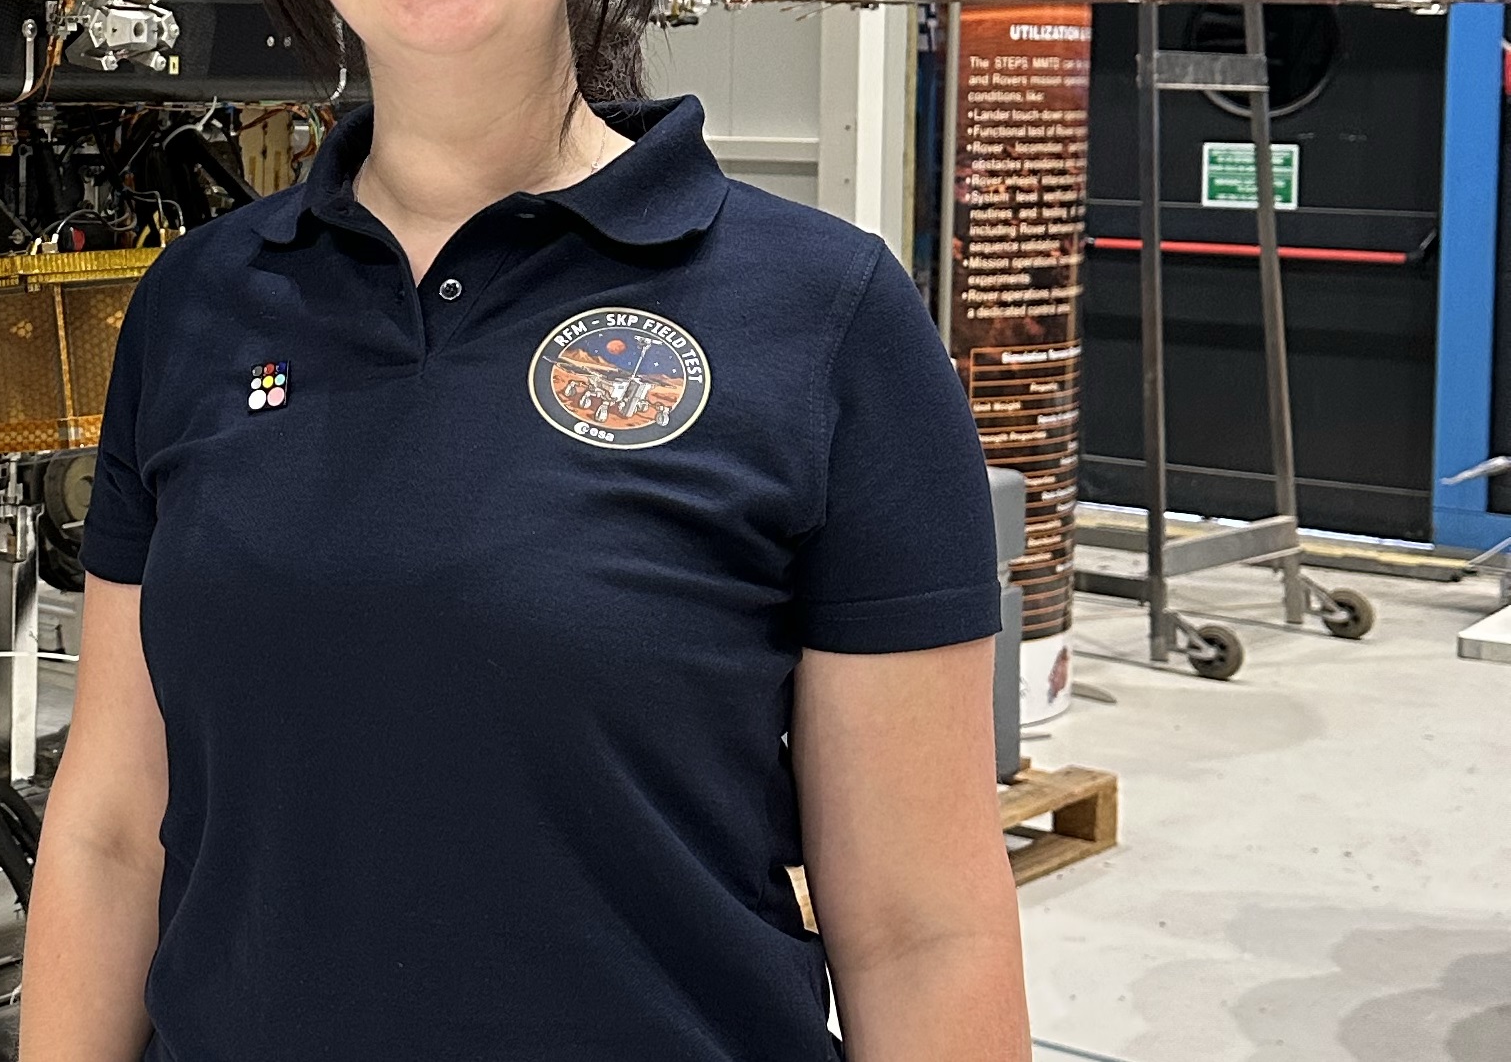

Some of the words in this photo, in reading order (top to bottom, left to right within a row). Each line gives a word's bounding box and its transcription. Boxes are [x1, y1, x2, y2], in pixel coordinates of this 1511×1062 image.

[1010, 24, 1080, 41] UTILIZATION
[969, 55, 989, 69] The
[994, 55, 1028, 70] STEPS
[969, 73, 989, 87] and
[974, 107, 1010, 121] Lander
[972, 140, 1004, 154] Rover
[553, 321, 588, 347] RFM
[605, 313, 638, 326] SKP
[642, 318, 687, 349] FIELD
[682, 348, 703, 384] TEST
